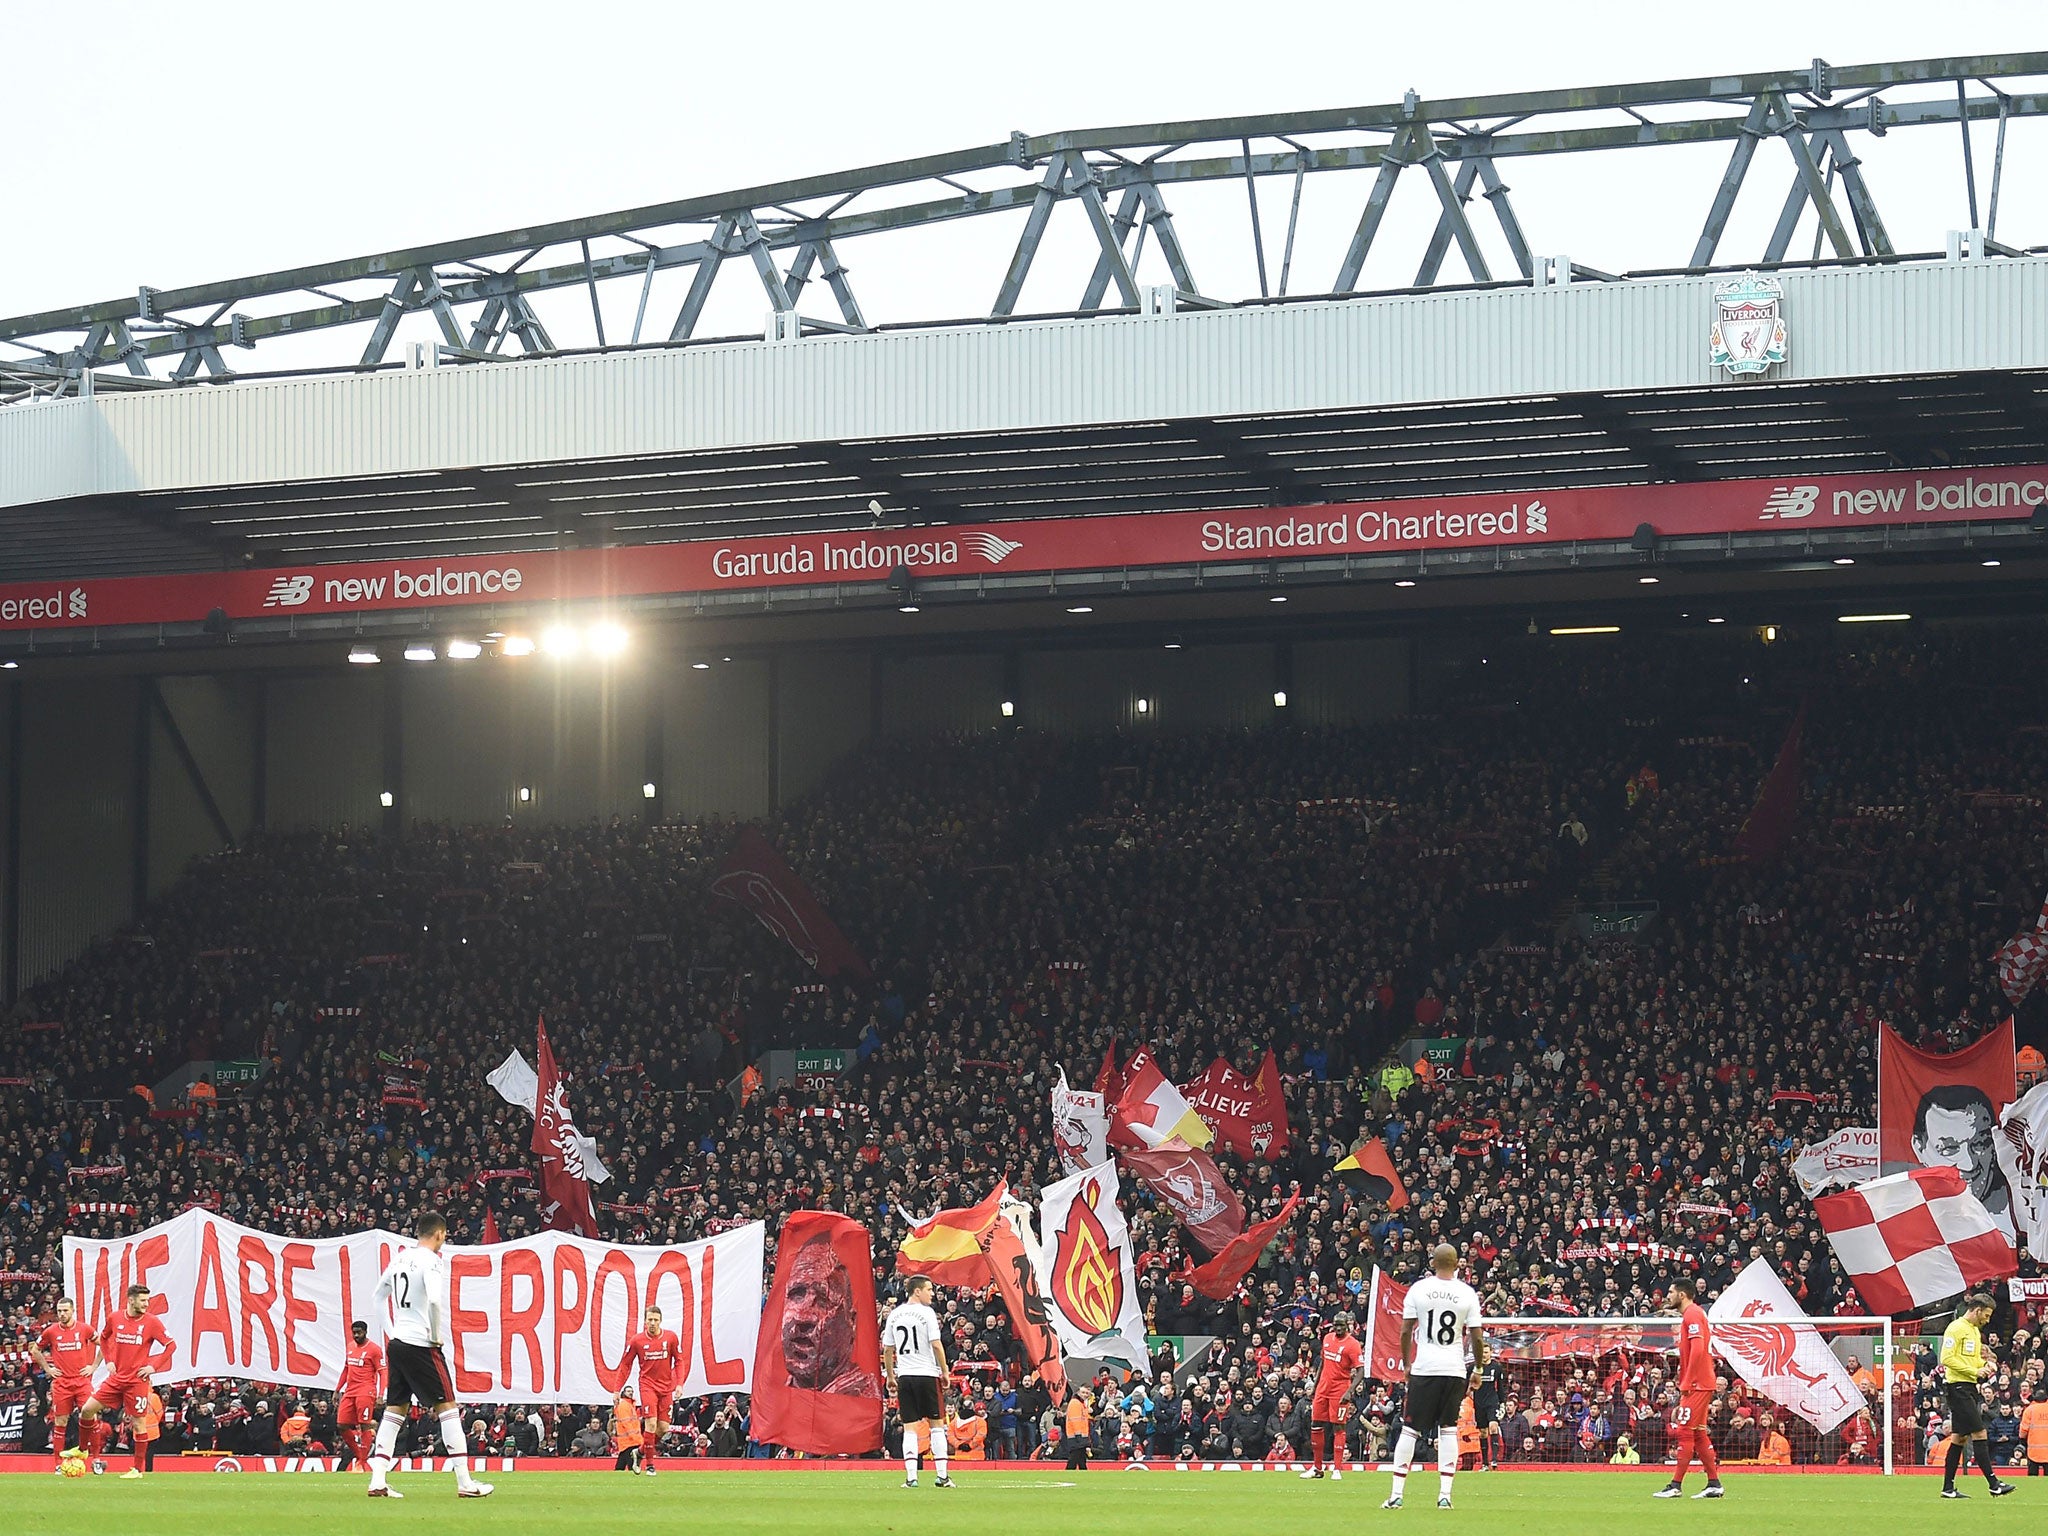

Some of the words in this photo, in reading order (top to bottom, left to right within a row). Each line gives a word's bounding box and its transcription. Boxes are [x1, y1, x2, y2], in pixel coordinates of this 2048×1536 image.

[1723, 308, 1772, 320] LIVERPOOL
[1833, 487, 1907, 516] new
[1915, 477, 2048, 512] balanc
[1201, 504, 1347, 552] Standard
[1356, 503, 1519, 542] Chartered
[712, 544, 814, 578] Garuda
[823, 540, 958, 571] Indonesia
[324, 577, 387, 603] new
[393, 567, 522, 599] balance
[0, 590, 63, 621] ered
[1593, 922, 1616, 932] EXIT
[1428, 1049, 1452, 1059] EXIT
[797, 1060, 819, 1070] EXIT
[216, 1070, 237, 1080] EXIT
[1436, 1067, 1456, 1080] 20
[1250, 1121, 1274, 1135] 2005
[393, 1271, 411, 1309] 12
[2023, 1280, 2048, 1295] YOU'
[1426, 1290, 1460, 1304] YOUNG
[74, 1234, 174, 1374] WE
[190, 1221, 321, 1377] ARE
[337, 1242, 746, 1395] LERPOOL
[1427, 1308, 1457, 1346] 18
[896, 1325, 919, 1355] 21
[1874, 1344, 1900, 1356] EIT
[135, 1396, 147, 1410] 20
[362, 1407, 369, 1420] 4
[1337, 1406, 1347, 1420] 17
[1678, 1406, 1691, 1421] 23
